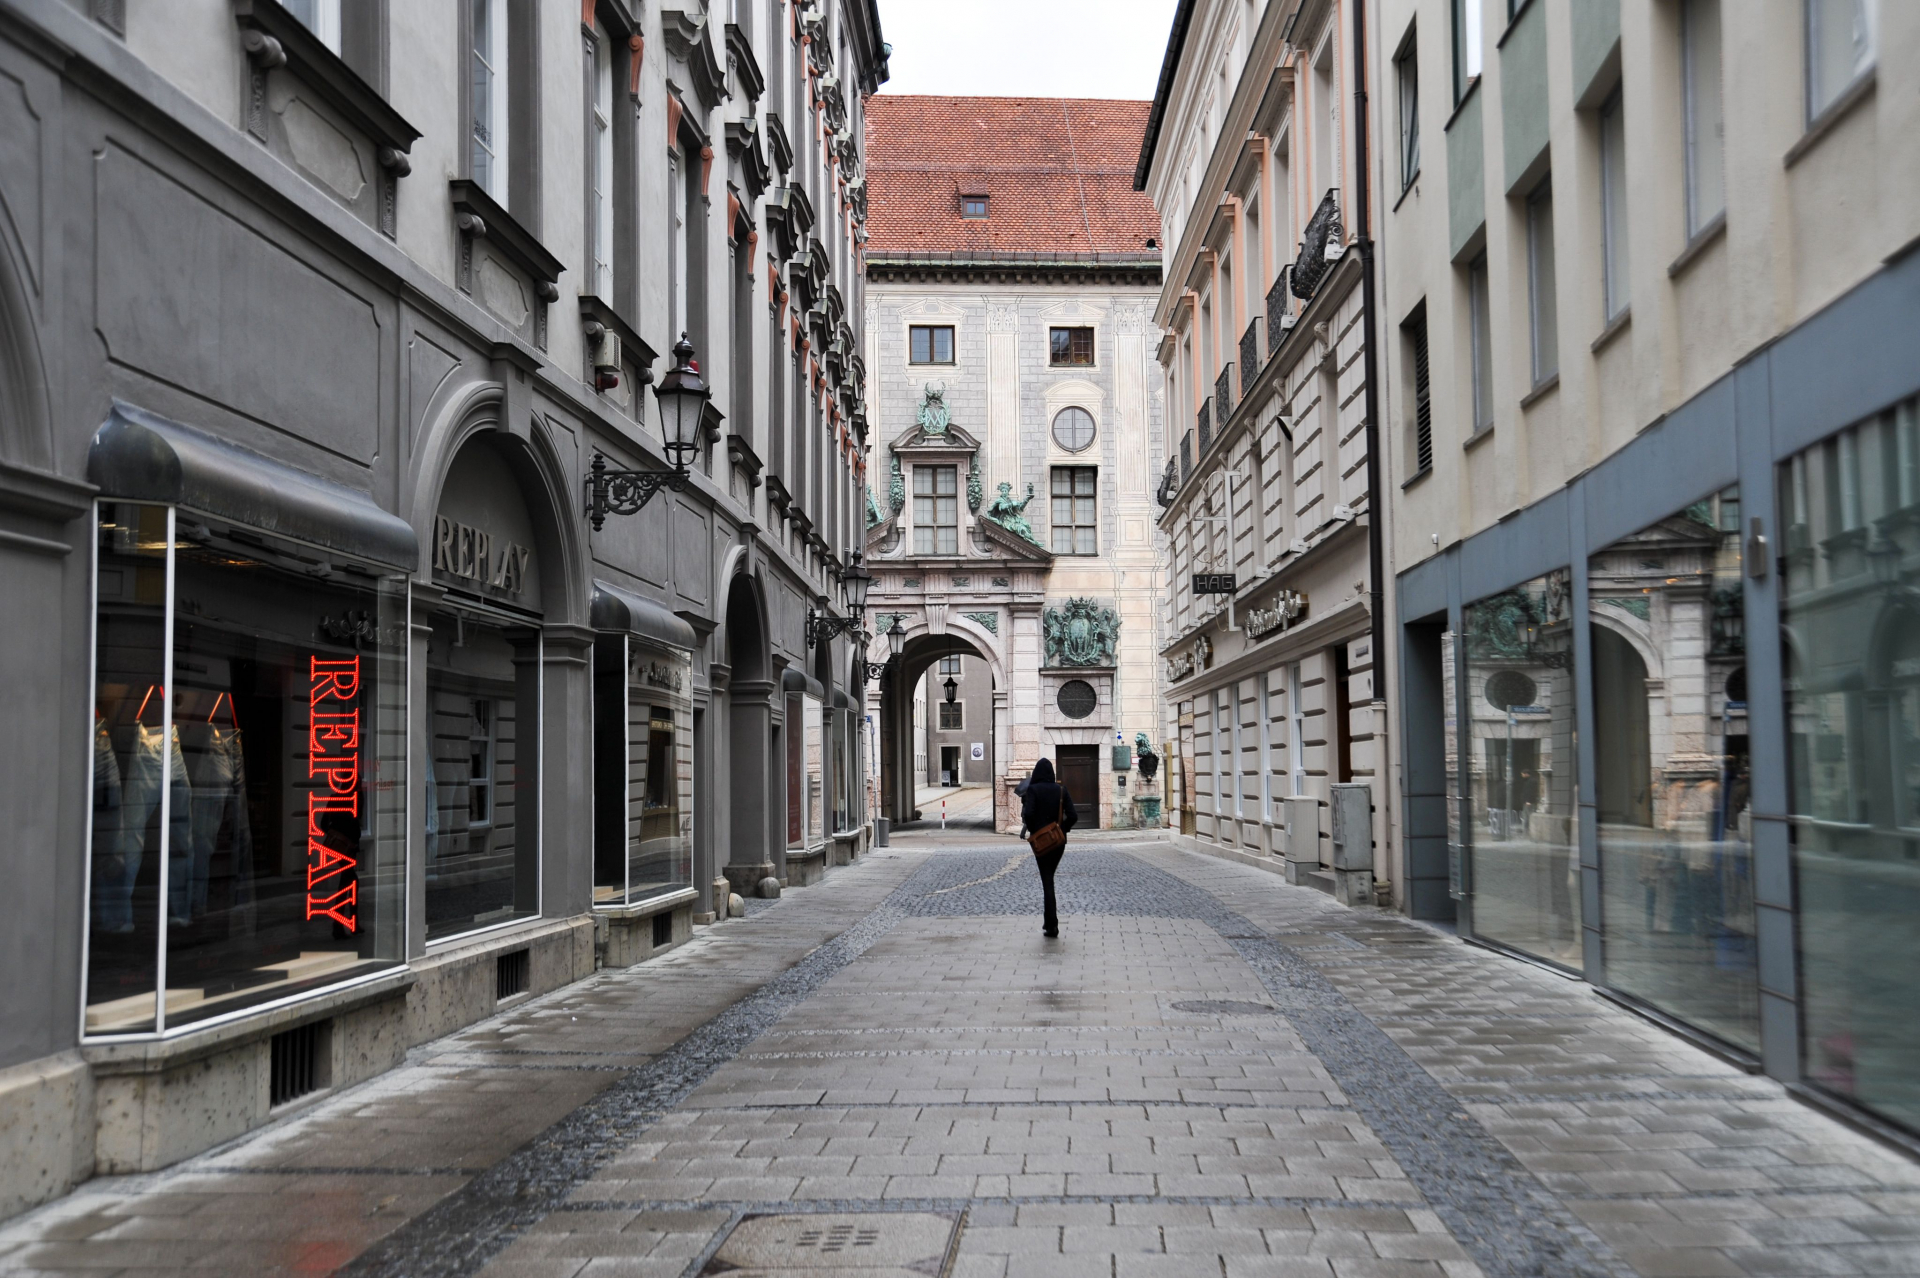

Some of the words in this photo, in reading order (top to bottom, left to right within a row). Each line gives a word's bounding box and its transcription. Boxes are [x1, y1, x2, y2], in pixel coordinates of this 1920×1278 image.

[434, 513, 530, 595] REPLAY
[1196, 576, 1233, 591] HAG
[306, 654, 360, 932] REPLAY
